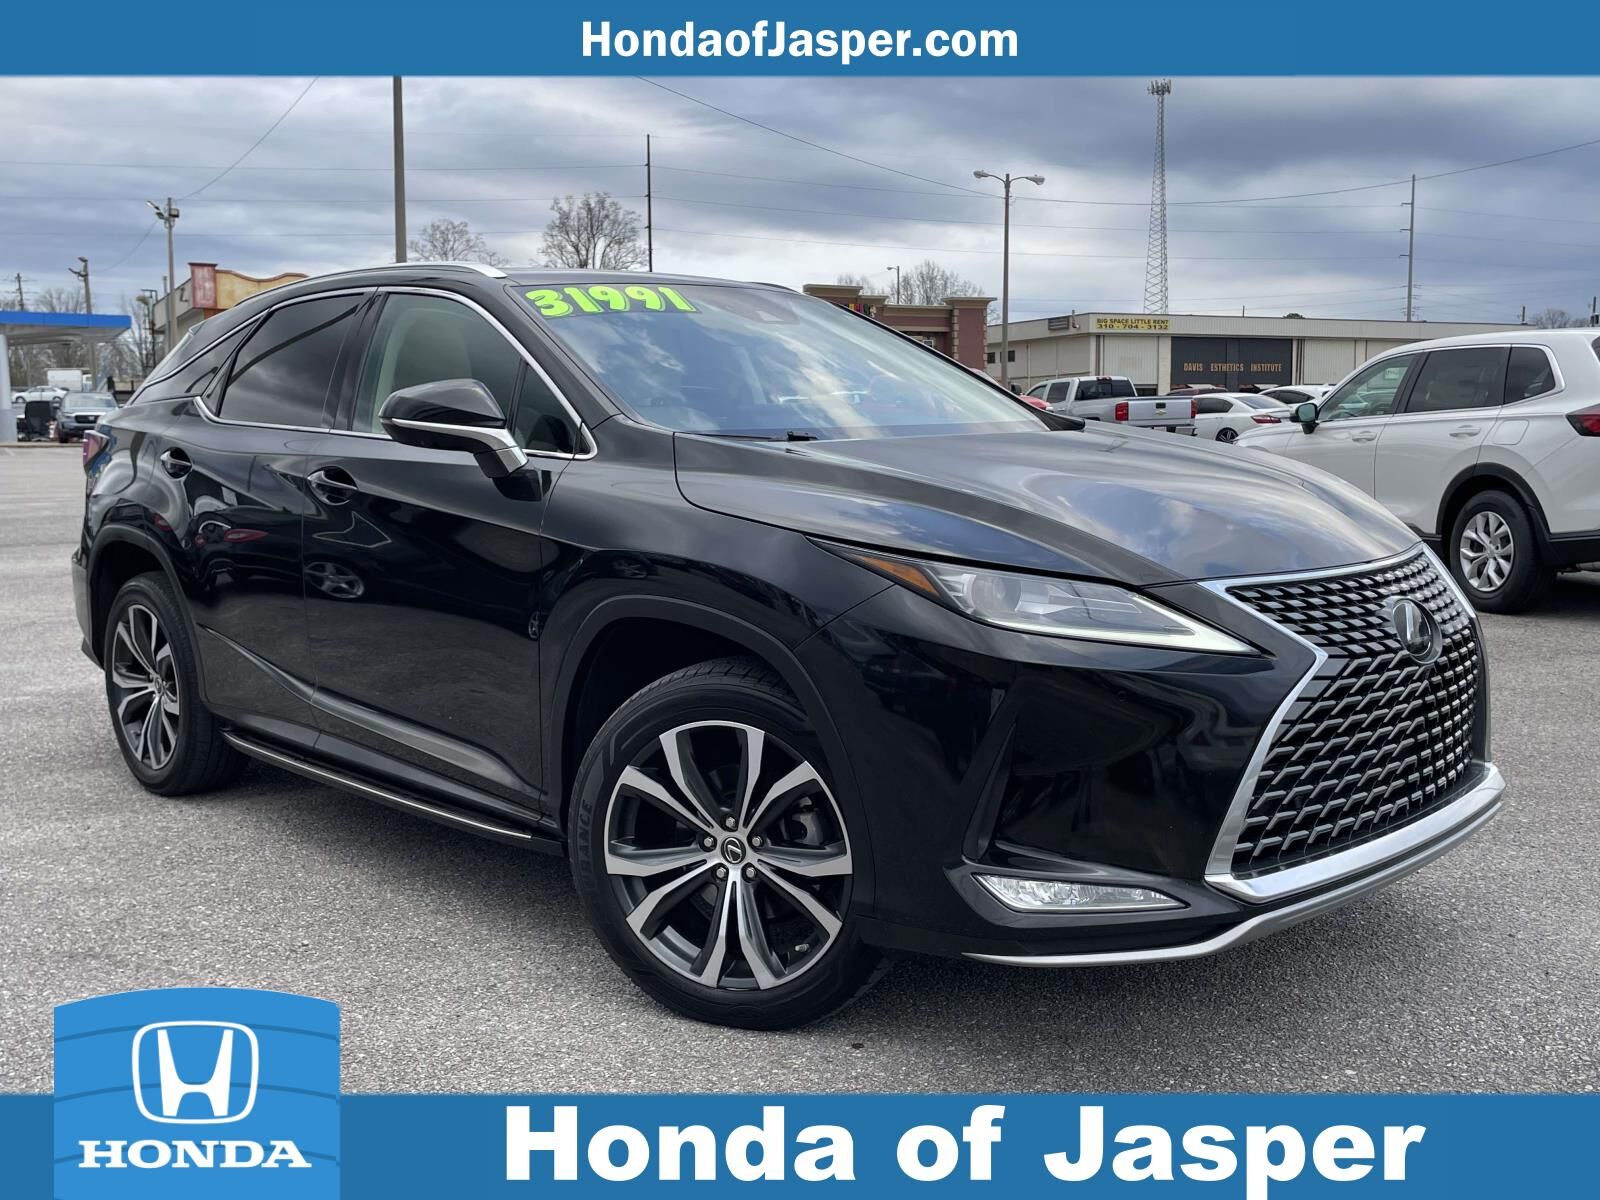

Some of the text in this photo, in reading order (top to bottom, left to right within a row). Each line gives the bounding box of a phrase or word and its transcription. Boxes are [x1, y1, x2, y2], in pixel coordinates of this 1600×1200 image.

[526, 285, 697, 317] 31991
[1183, 362, 1282, 372] DAVIS ESTHETICS INSTITUTE
